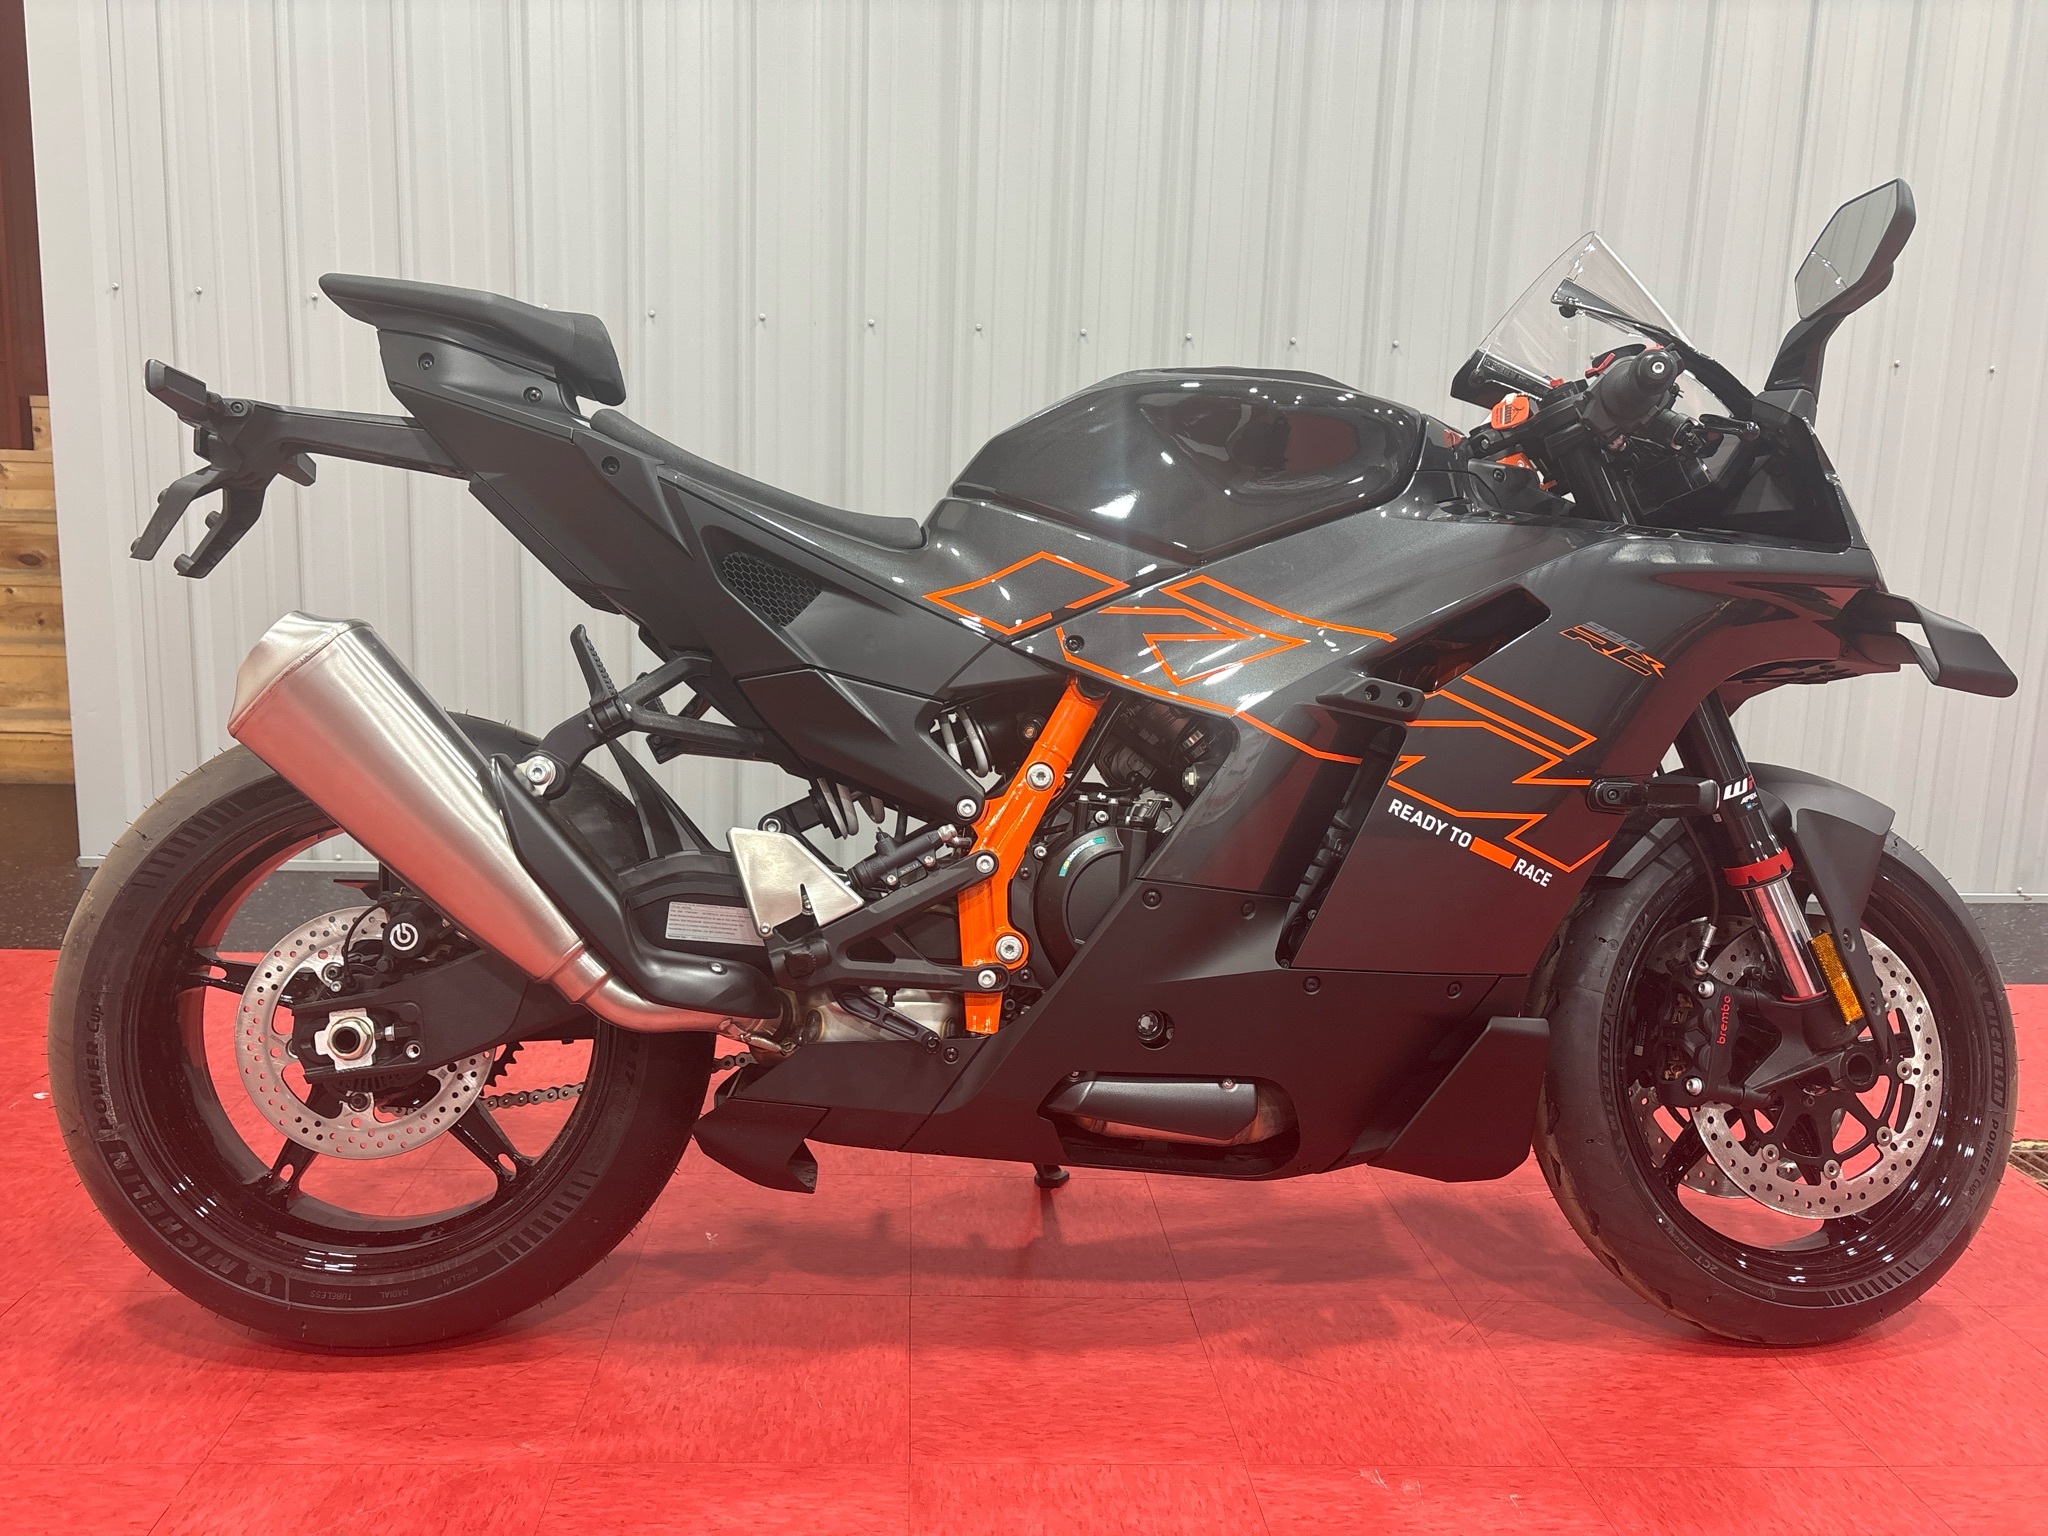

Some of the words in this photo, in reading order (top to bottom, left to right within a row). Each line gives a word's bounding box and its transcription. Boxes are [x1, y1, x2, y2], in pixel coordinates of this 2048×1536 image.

[1582, 621, 1646, 651] 990
[1388, 799, 1449, 836] READY
[1449, 826, 1472, 848] TO
[1513, 858, 1553, 887] RACE
[1716, 995, 1731, 1045] brembo
[1600, 1014, 1618, 1131] MICHELIN
[1984, 1000, 2005, 1107] MICHELIN
[86, 1041, 115, 1130] POWER
[1979, 1119, 1999, 1176] POWER
[109, 1150, 240, 1275] MICHELIN
[1665, 1225, 1690, 1251] FRONT
[1694, 1255, 1719, 1274] 2CT
[309, 1289, 353, 1302] TUBELESS
[379, 1287, 409, 1300] RADIAL
